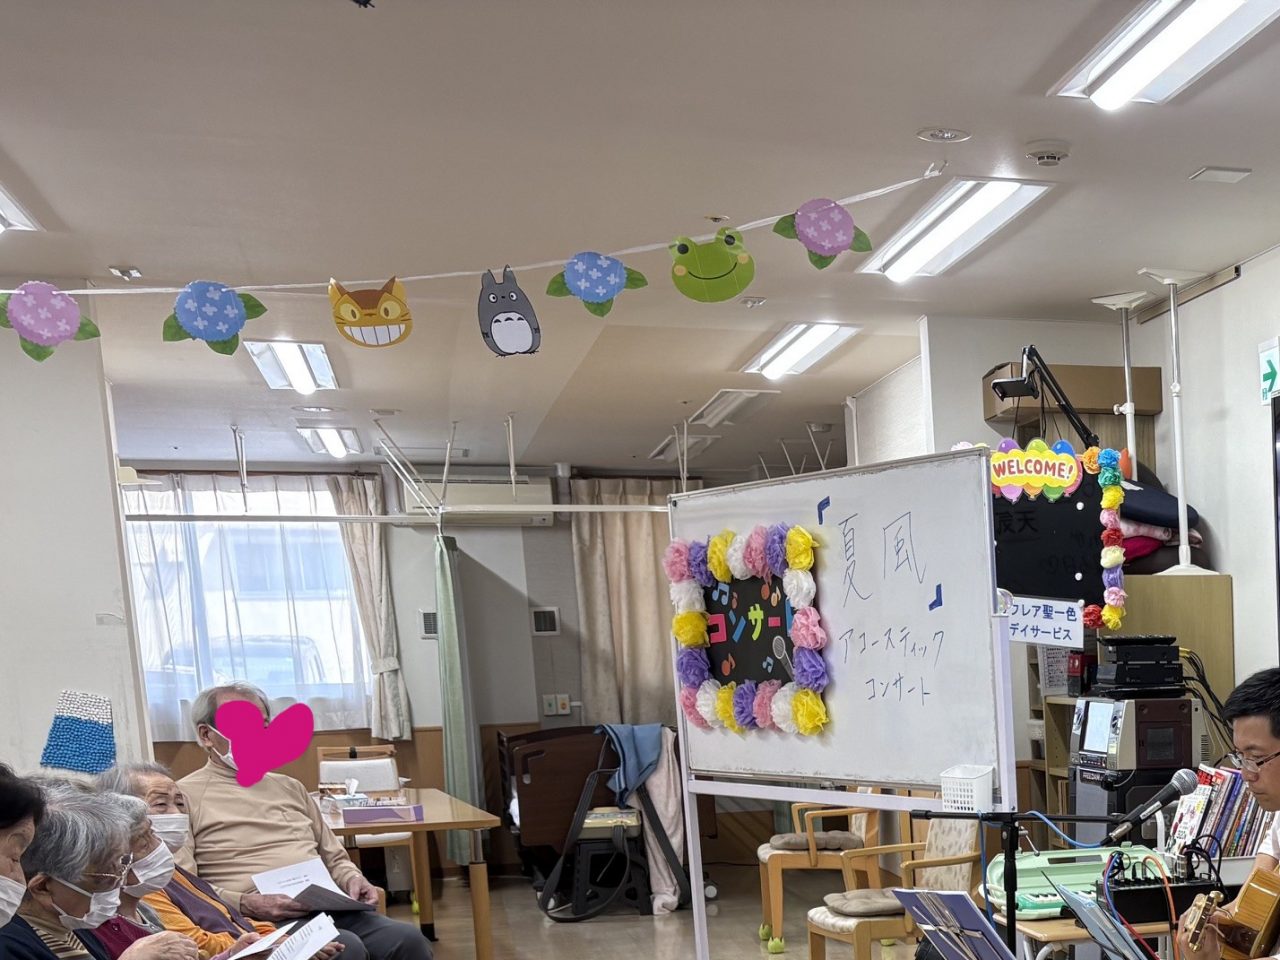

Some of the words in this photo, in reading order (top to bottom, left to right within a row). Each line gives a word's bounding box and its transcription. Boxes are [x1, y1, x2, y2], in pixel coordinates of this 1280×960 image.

[992, 459, 1074, 480] WELCOME!
[1003, 604, 1078, 622] フレア聖一色
[1009, 622, 1073, 641] デイサービス
[838, 626, 945, 671] アコースティック
[865, 672, 931, 707] コンサート
